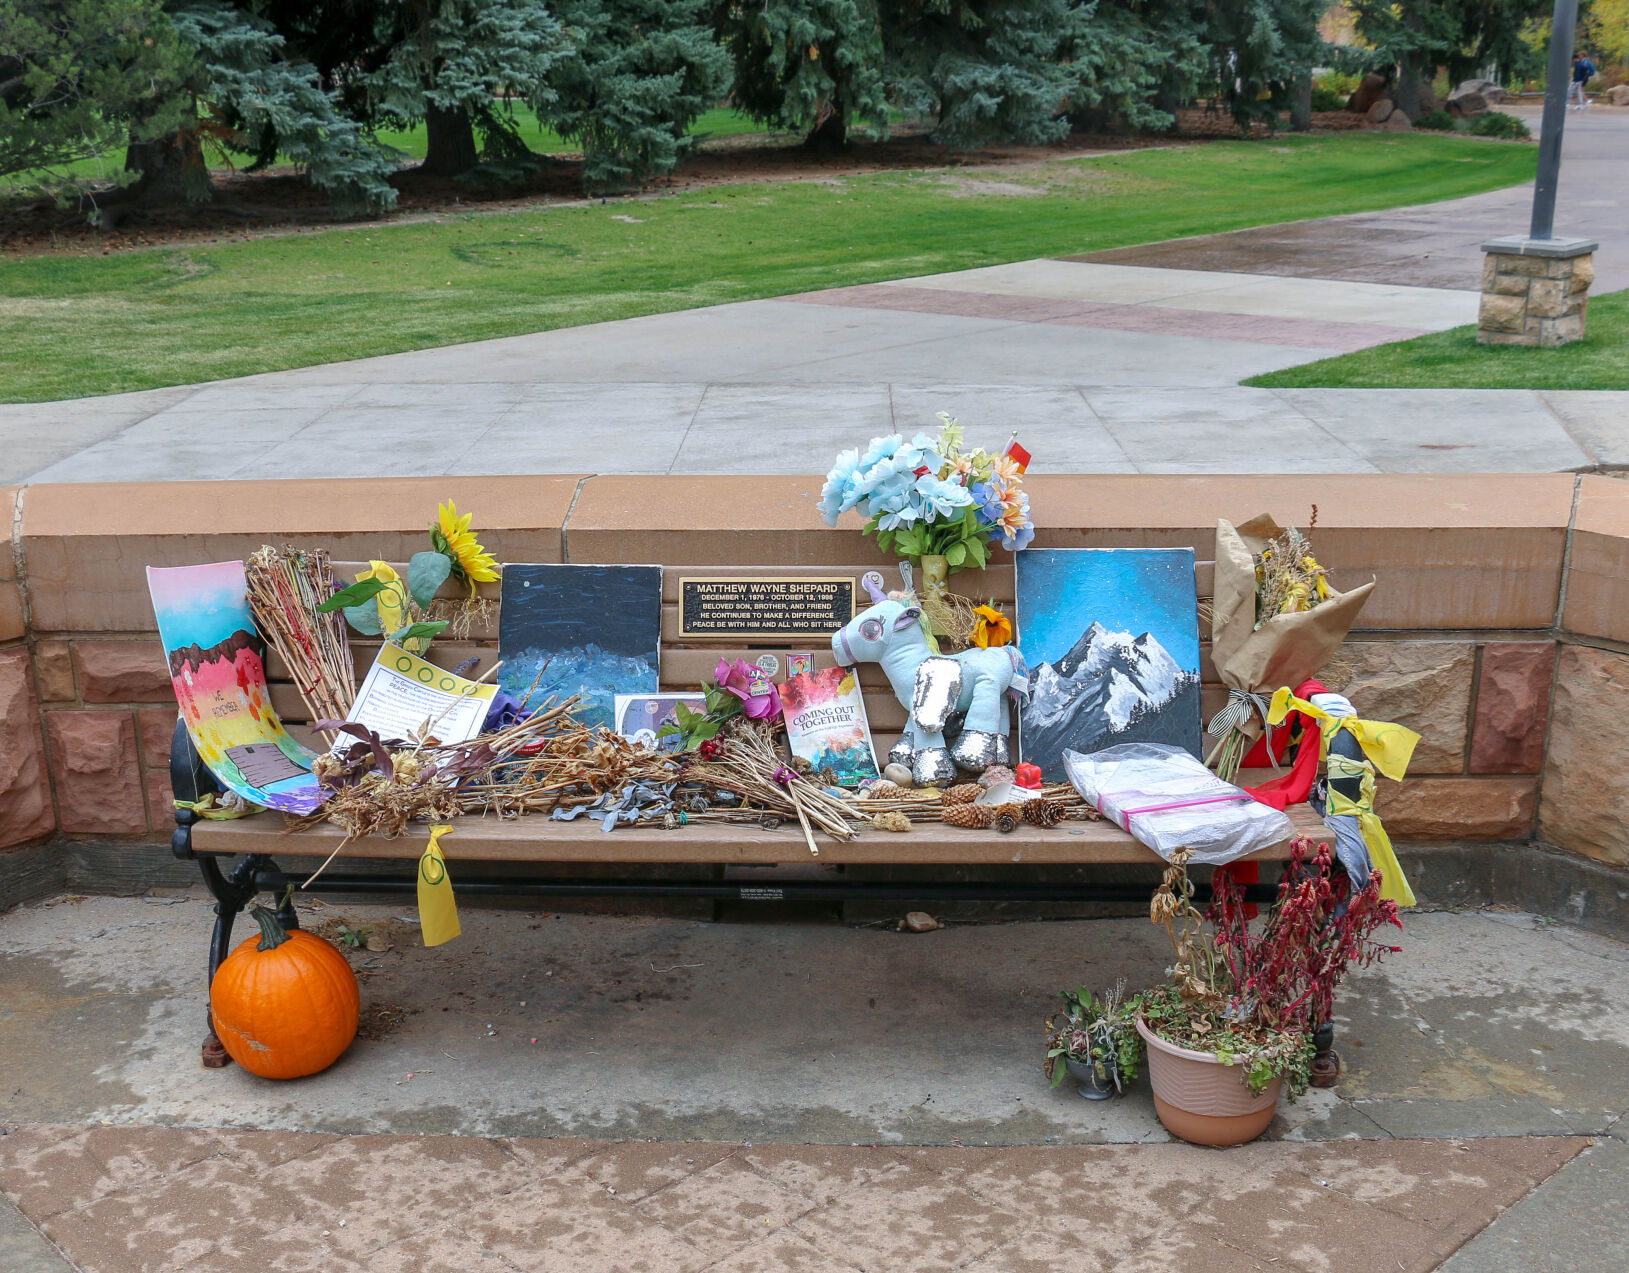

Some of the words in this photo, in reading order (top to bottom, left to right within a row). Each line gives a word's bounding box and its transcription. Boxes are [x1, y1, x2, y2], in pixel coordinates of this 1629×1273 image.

[697, 584, 747, 593] MATTHEW
[750, 584, 787, 593] WAYNE
[789, 584, 838, 593] SHEPARD
[741, 594, 747, 602] 1,
[806, 594, 816, 602] 12,
[735, 603, 752, 611] SON,
[754, 603, 789, 611] BROTHER,
[211, 690, 224, 702] WE
[793, 707, 834, 726] COMING
[834, 705, 855, 715] OUT
[800, 714, 852, 731] TOGETHER
